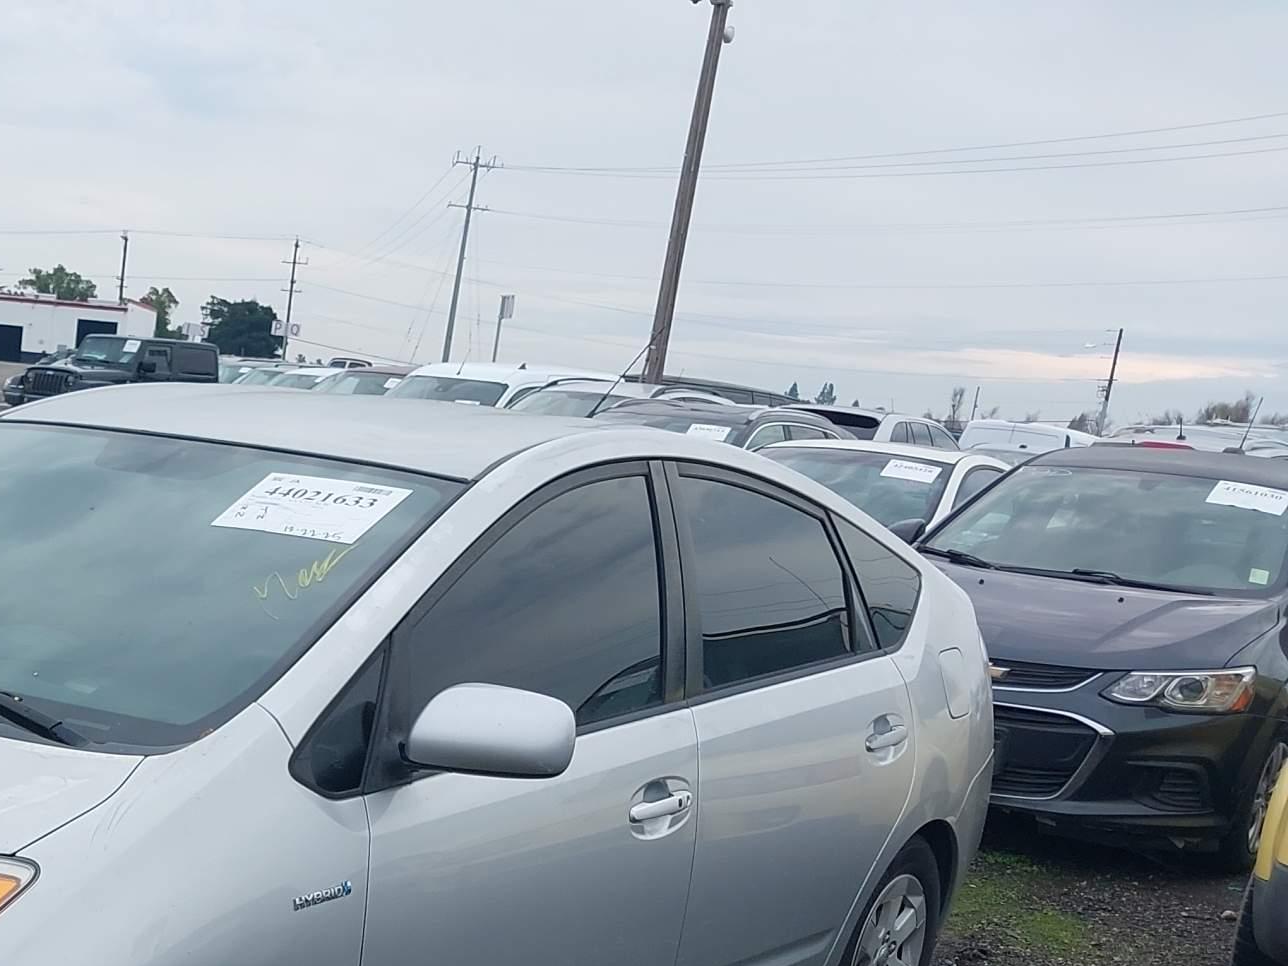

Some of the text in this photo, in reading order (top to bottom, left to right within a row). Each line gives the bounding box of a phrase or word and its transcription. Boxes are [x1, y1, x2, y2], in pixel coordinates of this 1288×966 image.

[199, 325, 206, 337] S
[274, 322, 300, 336] P Q
[265, 486, 379, 508] 44021633
[293, 886, 344, 911] HYBRID
